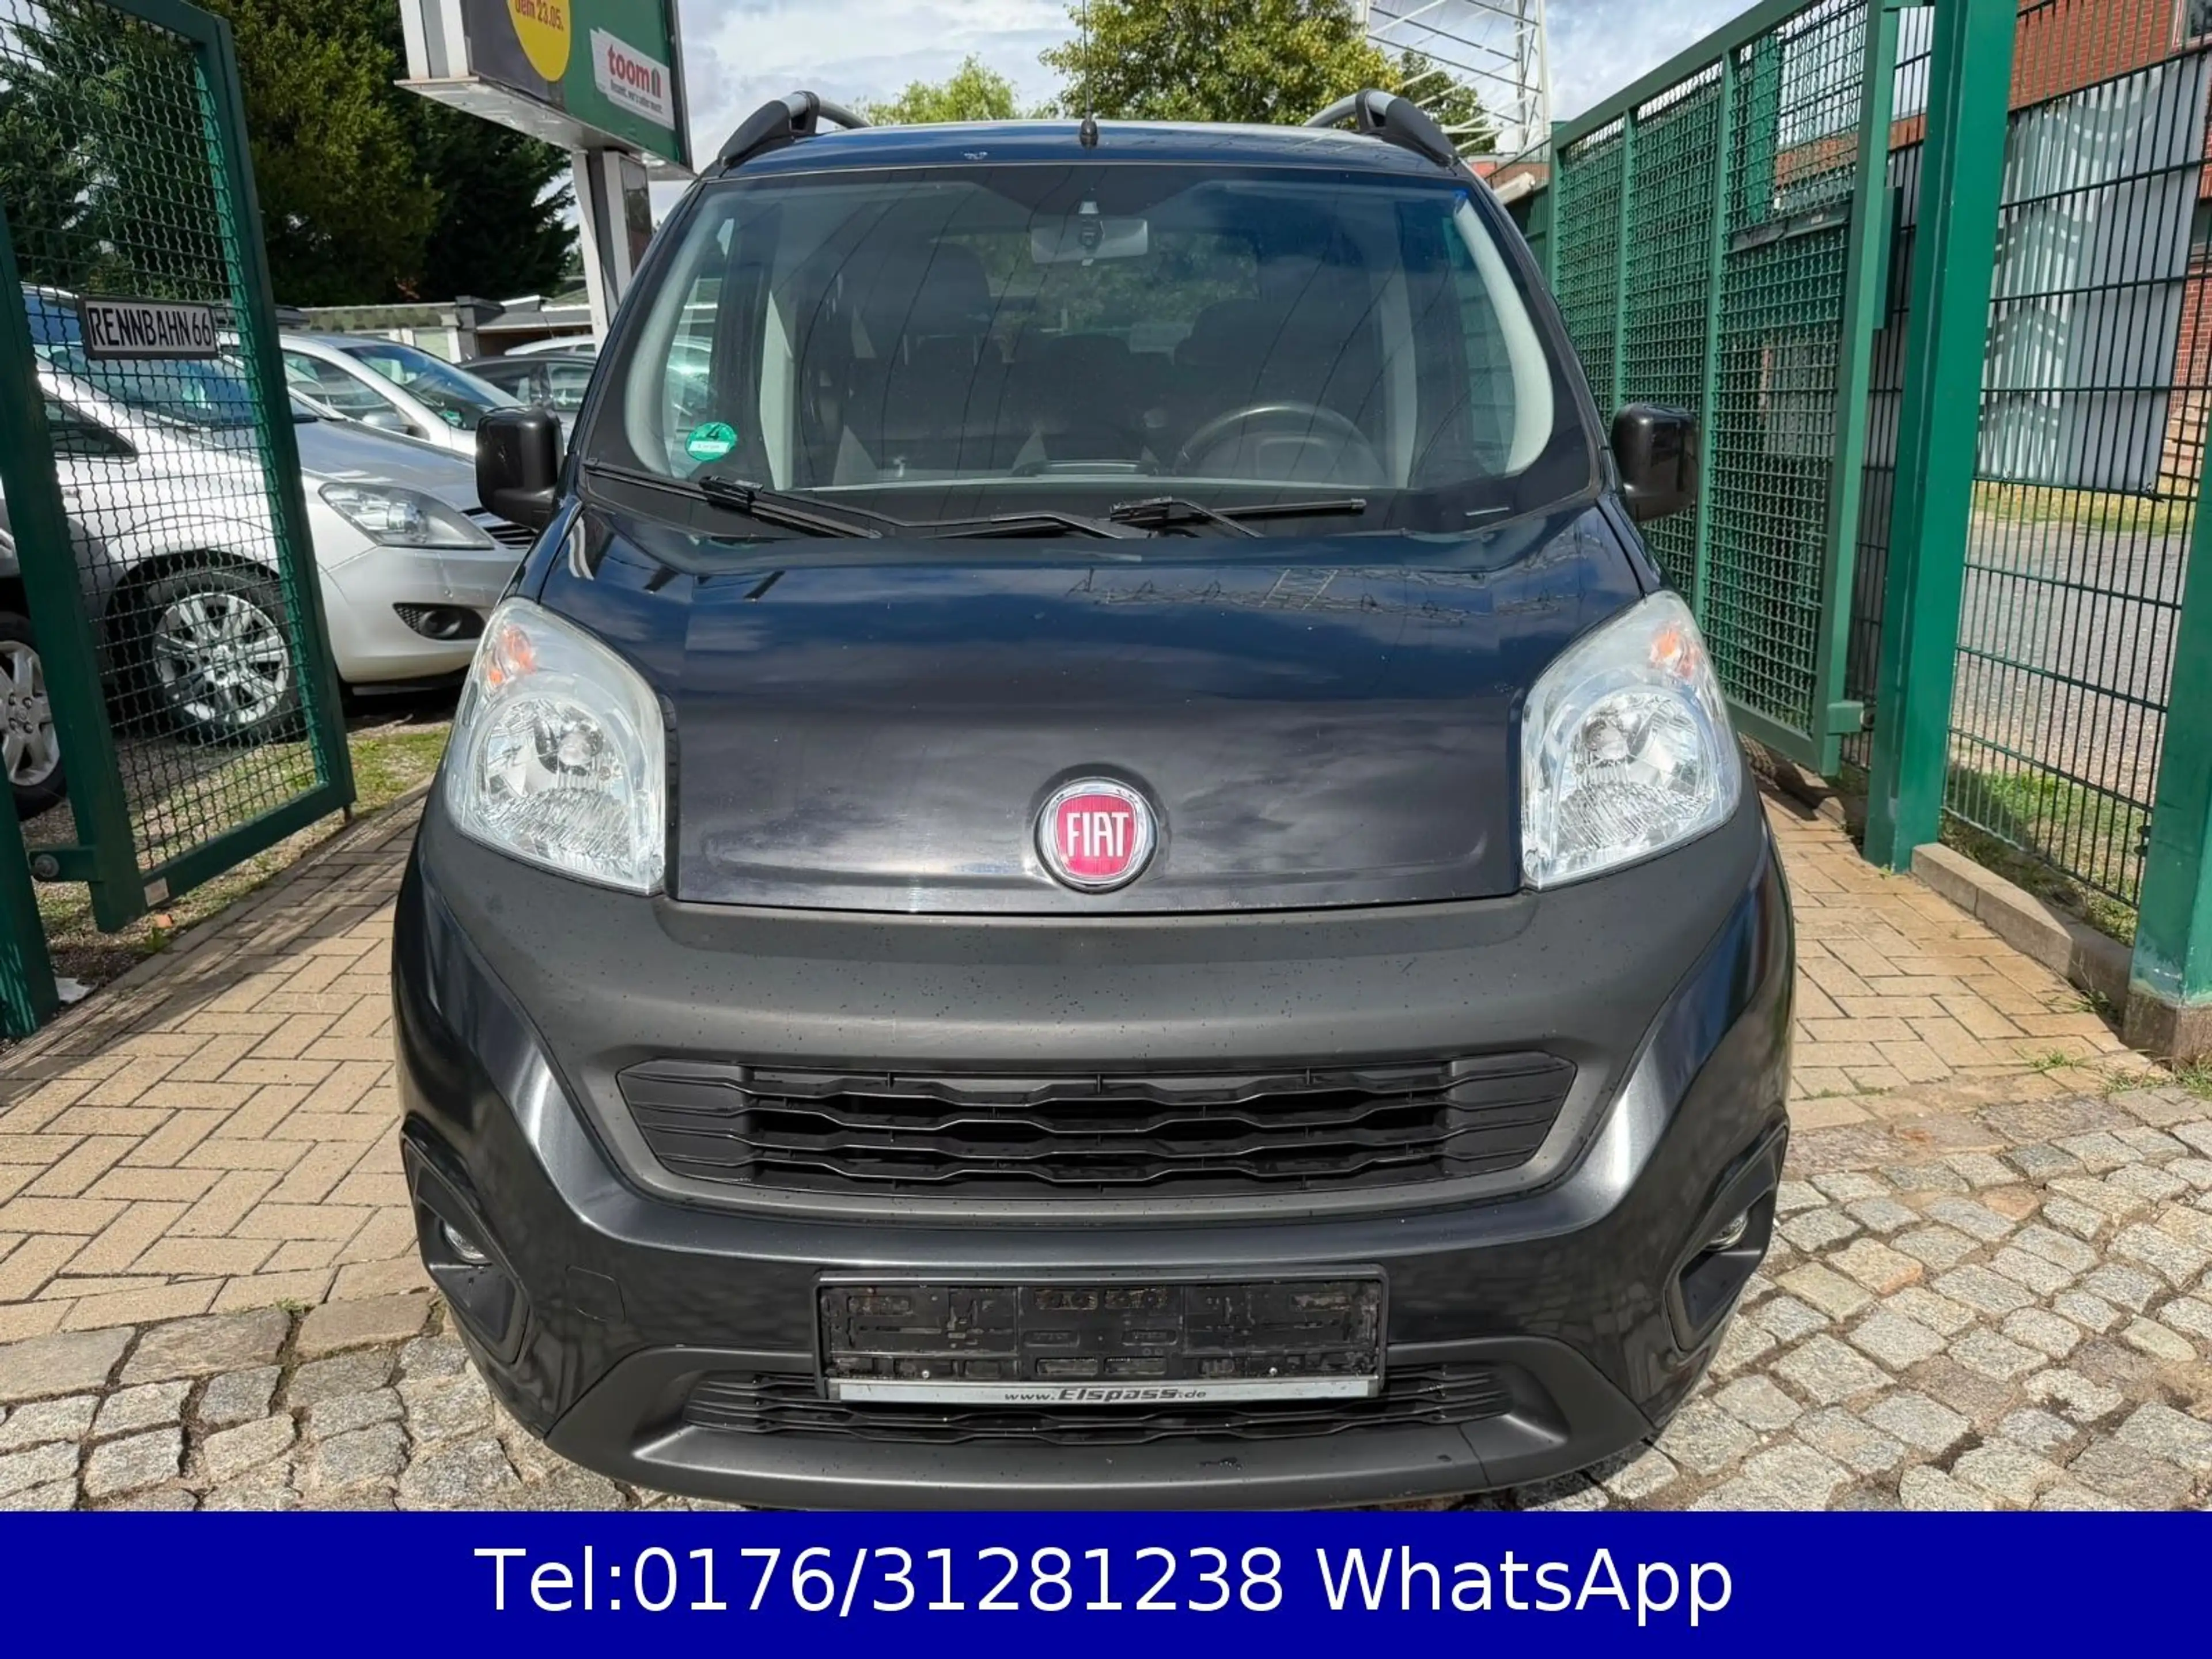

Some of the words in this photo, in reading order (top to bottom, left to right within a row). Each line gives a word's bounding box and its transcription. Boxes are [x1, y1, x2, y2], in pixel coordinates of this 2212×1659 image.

[608, 44, 650, 93] toom
[88, 308, 191, 346] RENNBAHN
[192, 312, 211, 345] 66
[706, 424, 720, 440] 4
[1066, 812, 1129, 857] FIAT
[1005, 1388, 1206, 1402] www.Elspass.de
